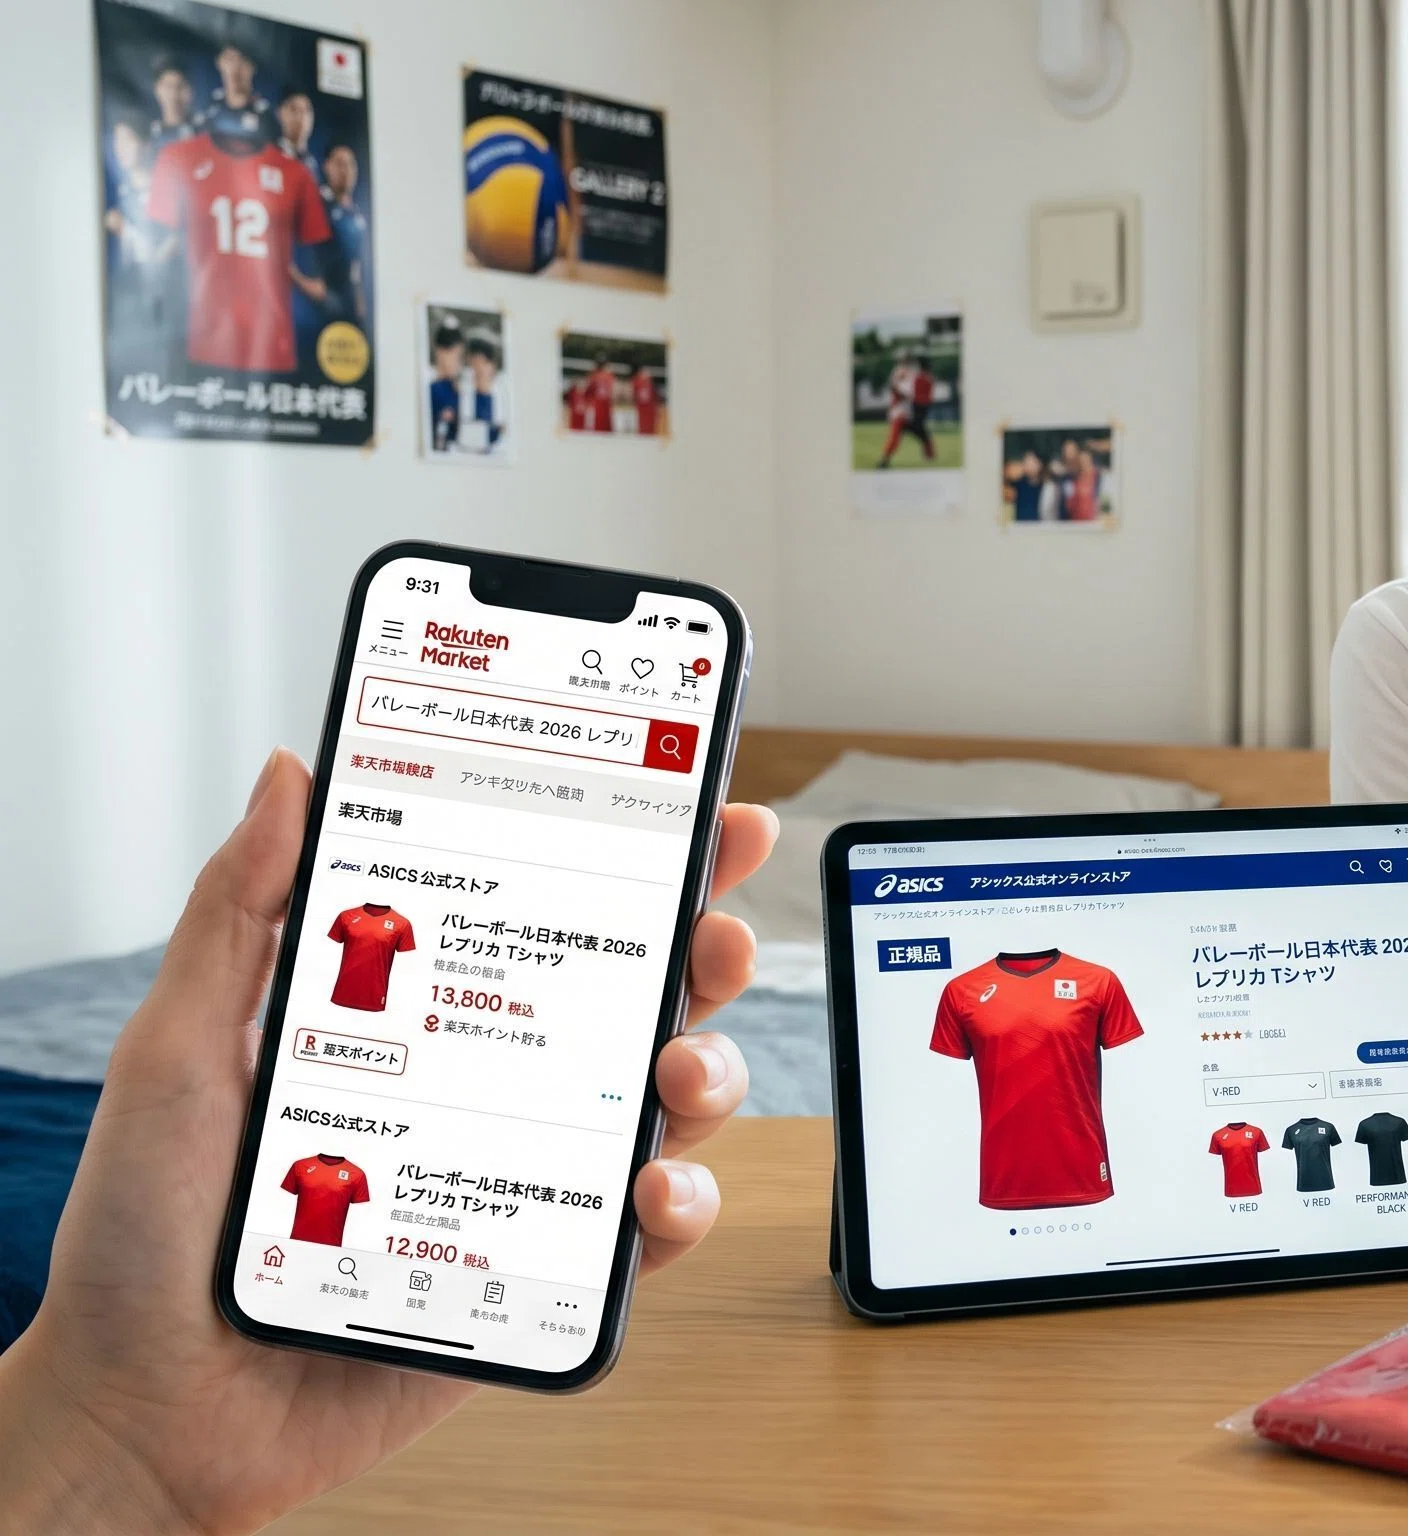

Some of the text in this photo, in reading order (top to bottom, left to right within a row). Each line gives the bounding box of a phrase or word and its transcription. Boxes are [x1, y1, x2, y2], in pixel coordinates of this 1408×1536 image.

[211, 196, 269, 258] 12
[118, 372, 366, 420] バレーボール日本代表
[405, 577, 440, 595] 9:31
[424, 621, 510, 651] Rakuten
[369, 644, 408, 656] メニュー
[420, 645, 490, 672] Market
[620, 683, 659, 698] ポイント
[671, 691, 701, 703] カート
[372, 695, 535, 735] バレーボール日本代表
[540, 720, 582, 741] 2026
[368, 863, 499, 895] ASICS 公式ストア
[442, 914, 647, 958] バレーボール日本代表 2026
[439, 935, 564, 968] レプリカ Tシャツ
[888, 945, 941, 964] 正規品
[1192, 937, 1378, 964] バレーボール日本代表
[1196, 965, 1336, 989] レプリカ Tシャツ
[431, 984, 503, 1013] 13,800
[305, 1034, 316, 1050] R
[1212, 1086, 1241, 1097] V-RED
[397, 1163, 603, 1210] バレーボール日本代表 2026
[462, 1197, 519, 1219] Tシャツ
[1229, 1202, 1258, 1213] V RED
[1303, 1197, 1331, 1208] V RED
[1377, 1203, 1406, 1214] BLACK
[384, 1235, 458, 1265] 12,900
[255, 1272, 283, 1286] ホーム
